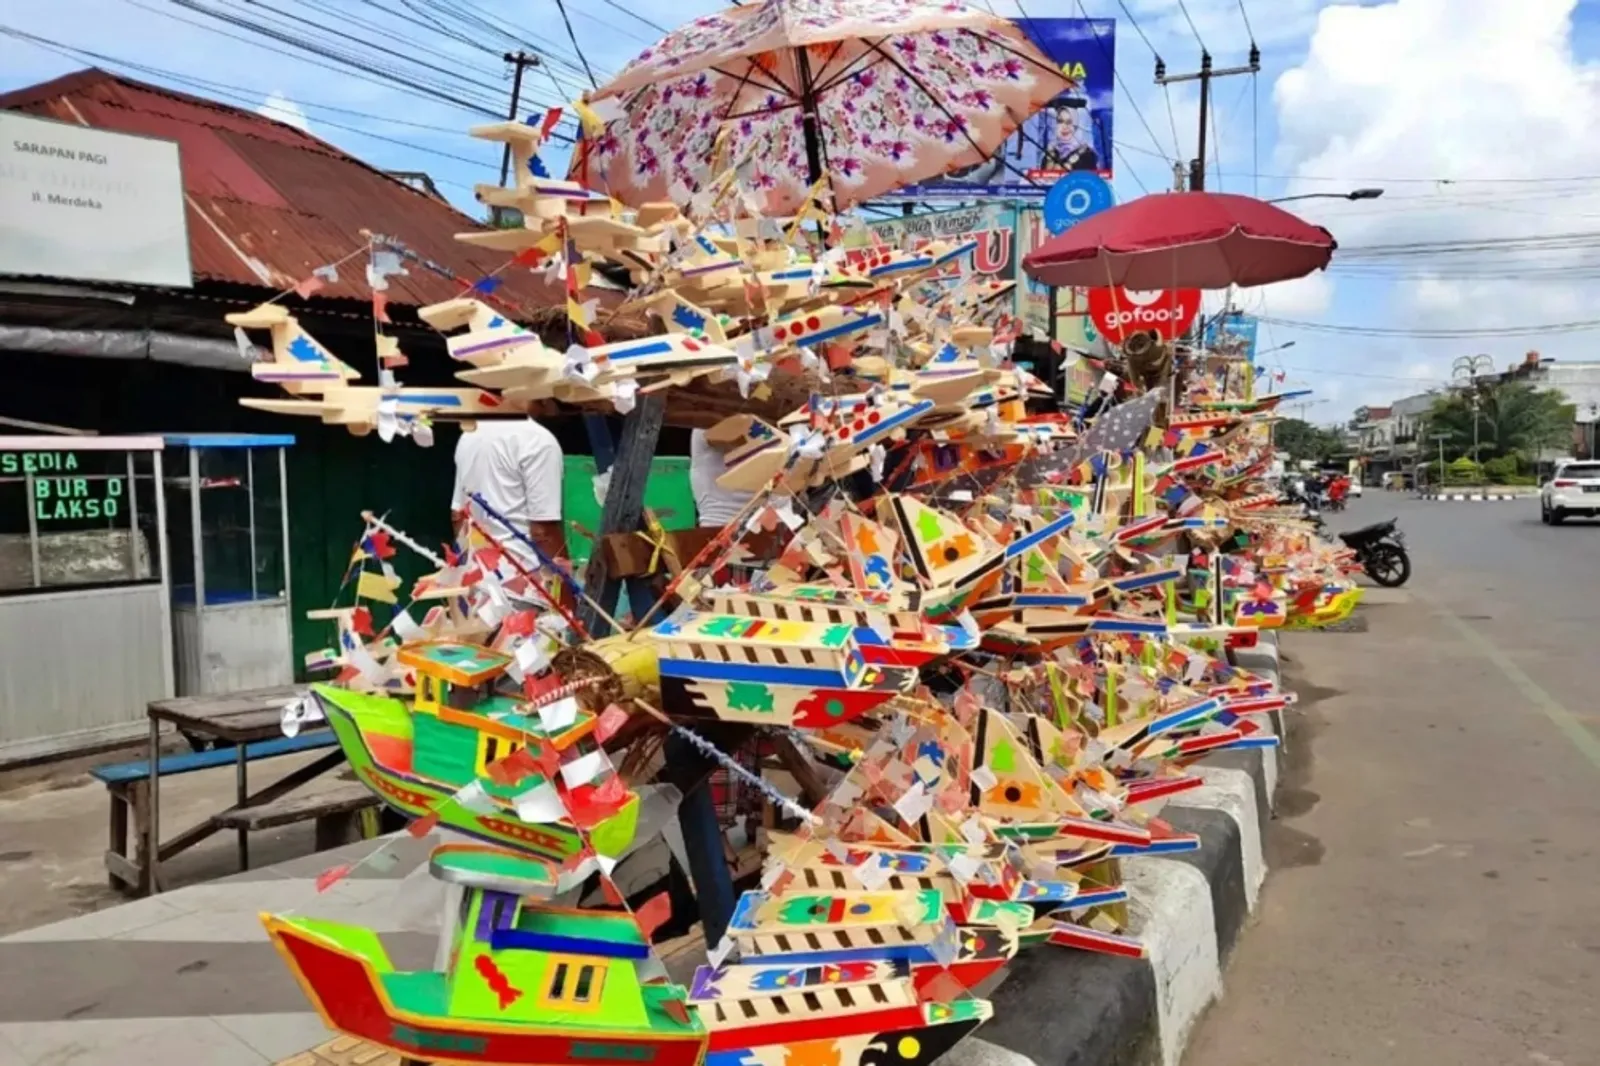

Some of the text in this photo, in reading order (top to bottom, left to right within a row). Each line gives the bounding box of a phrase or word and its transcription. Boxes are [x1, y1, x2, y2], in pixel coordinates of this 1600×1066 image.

[13, 140, 108, 165] SARAPAN PAGI
[47, 193, 103, 210] Merdeka
[1104, 303, 1184, 330] gofood
[1, 452, 79, 473] SEDIA
[35, 498, 119, 520] LAKSO
